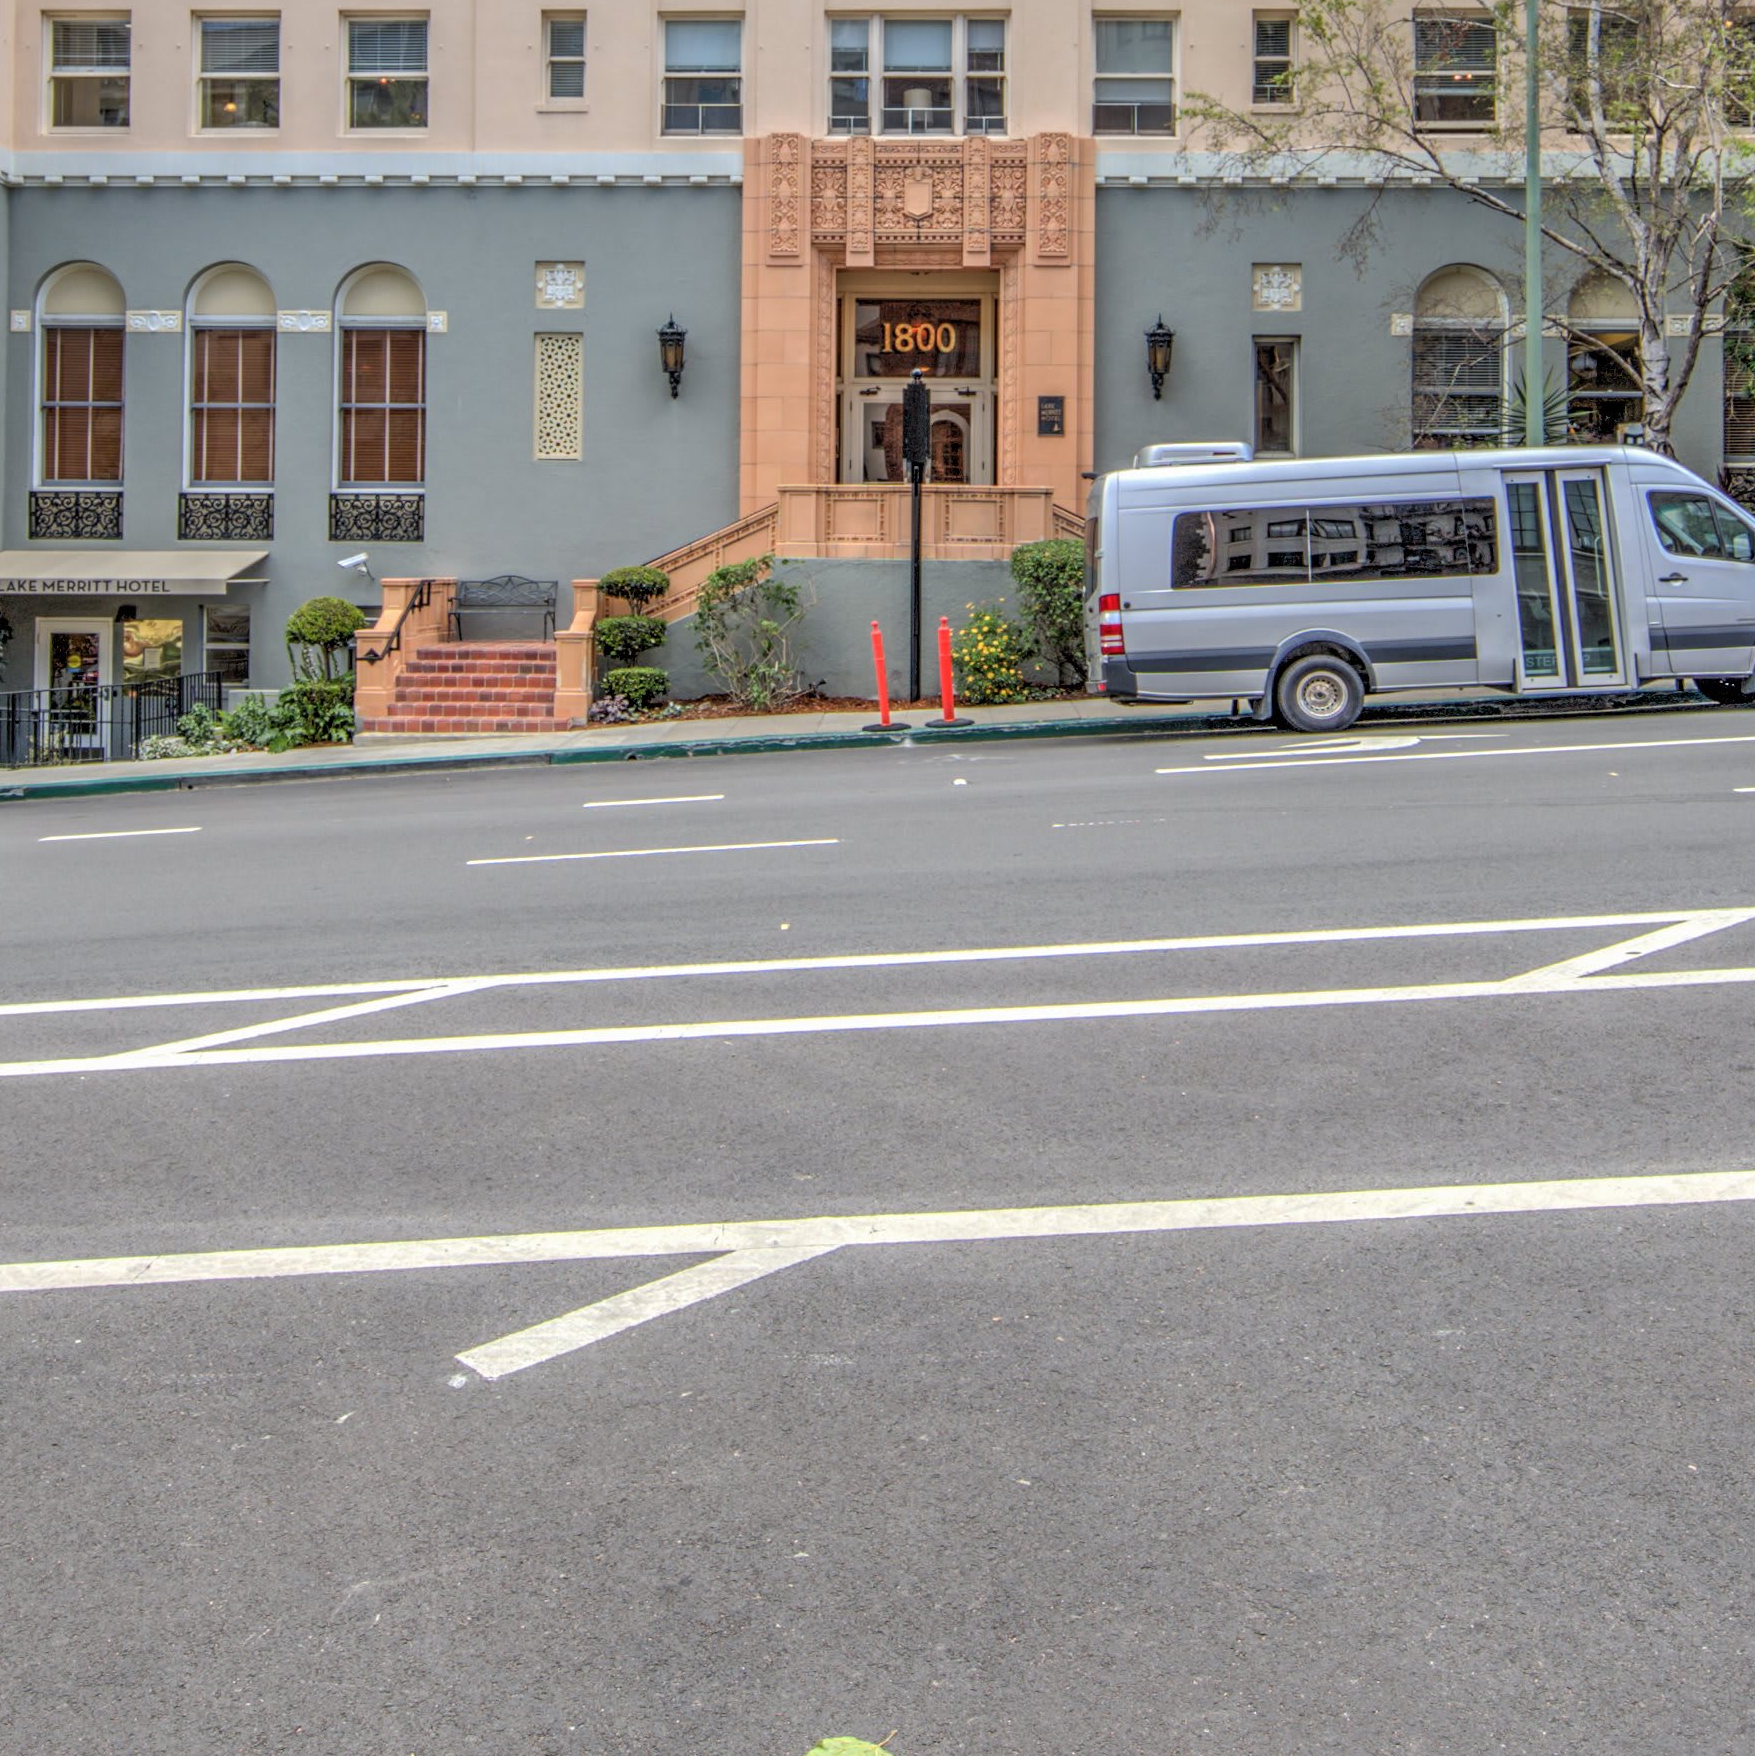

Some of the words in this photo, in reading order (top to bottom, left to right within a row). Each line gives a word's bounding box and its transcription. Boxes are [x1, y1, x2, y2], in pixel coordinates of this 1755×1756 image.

[882, 323, 956, 354] 1800
[42, 579, 112, 592] MERRITT
[116, 579, 171, 592] HOTEL
